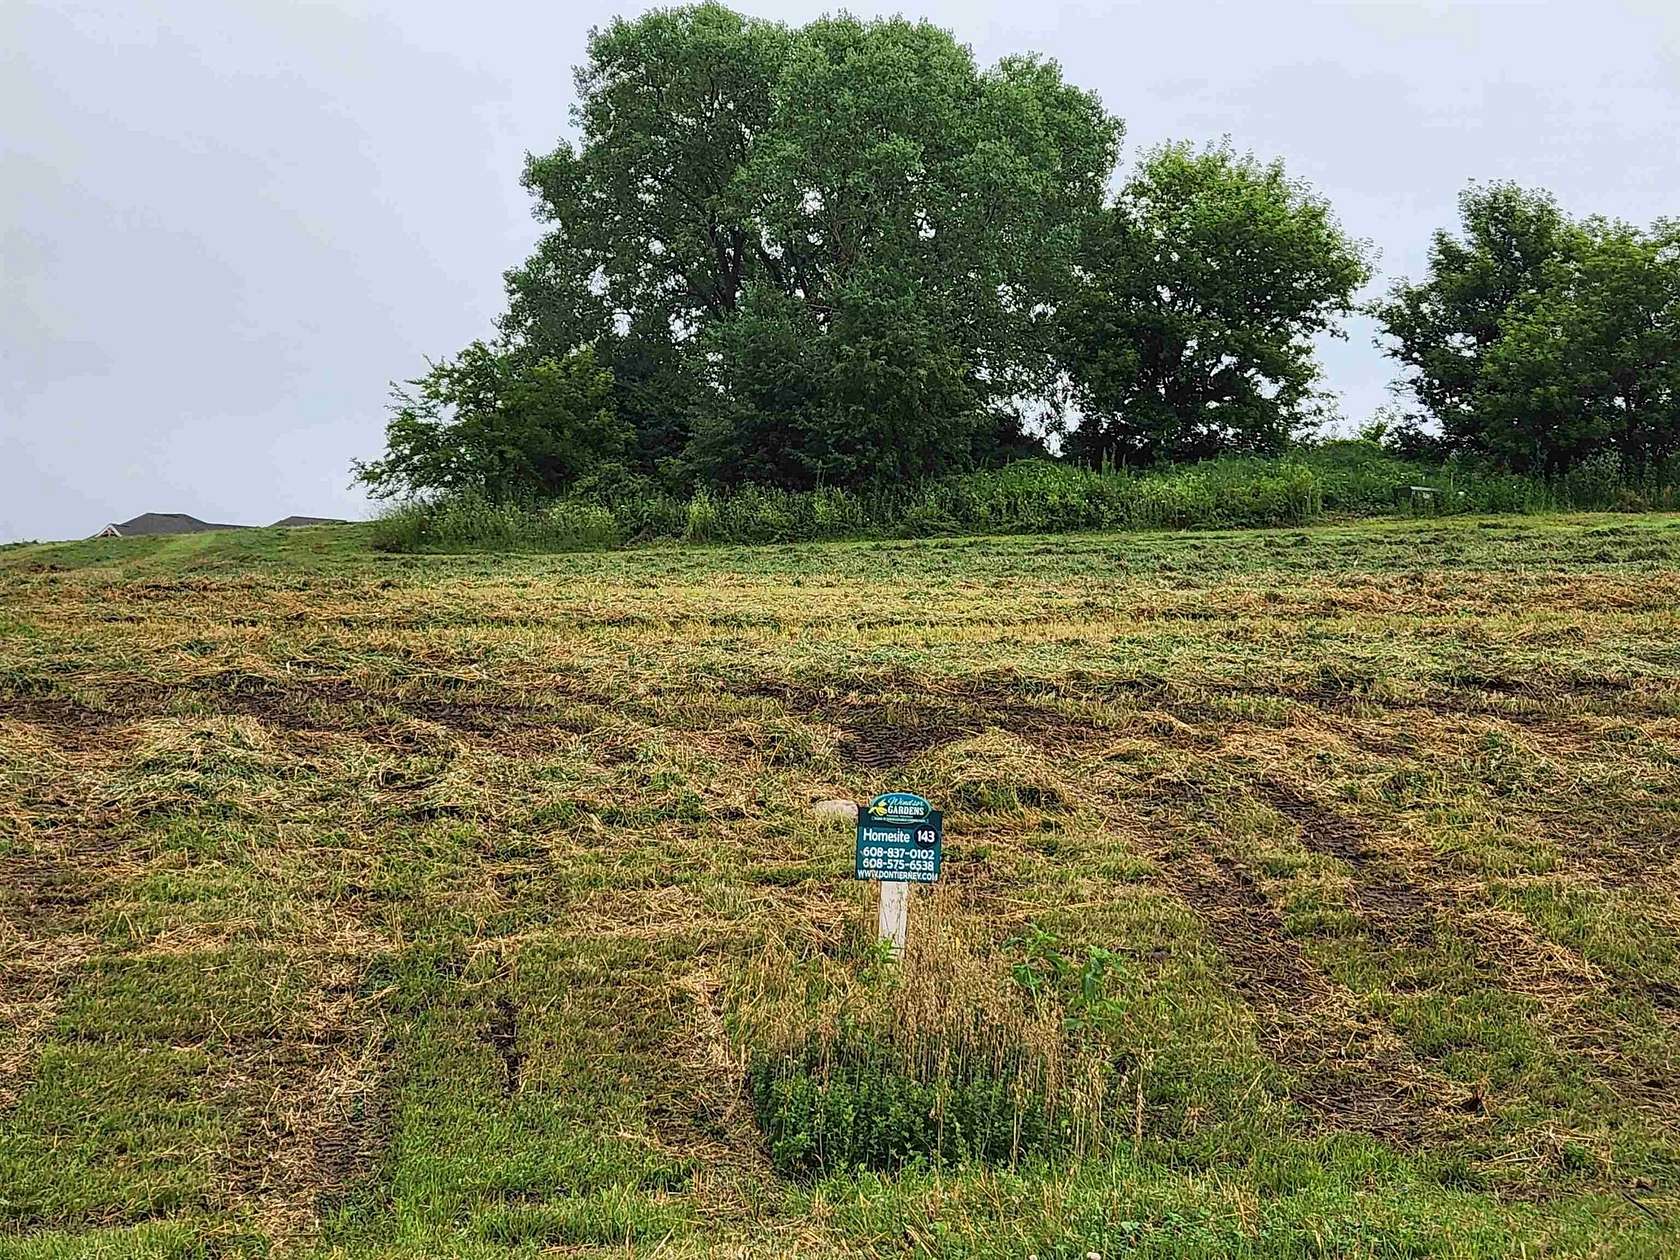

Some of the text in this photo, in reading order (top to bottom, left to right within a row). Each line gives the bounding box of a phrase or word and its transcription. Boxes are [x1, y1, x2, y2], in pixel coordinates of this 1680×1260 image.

[887, 806, 924, 816] GARDENS
[863, 828, 935, 843] Homesite 143
[863, 846, 934, 860] 608-837-0102
[862, 858, 934, 871] 608-575-6538
